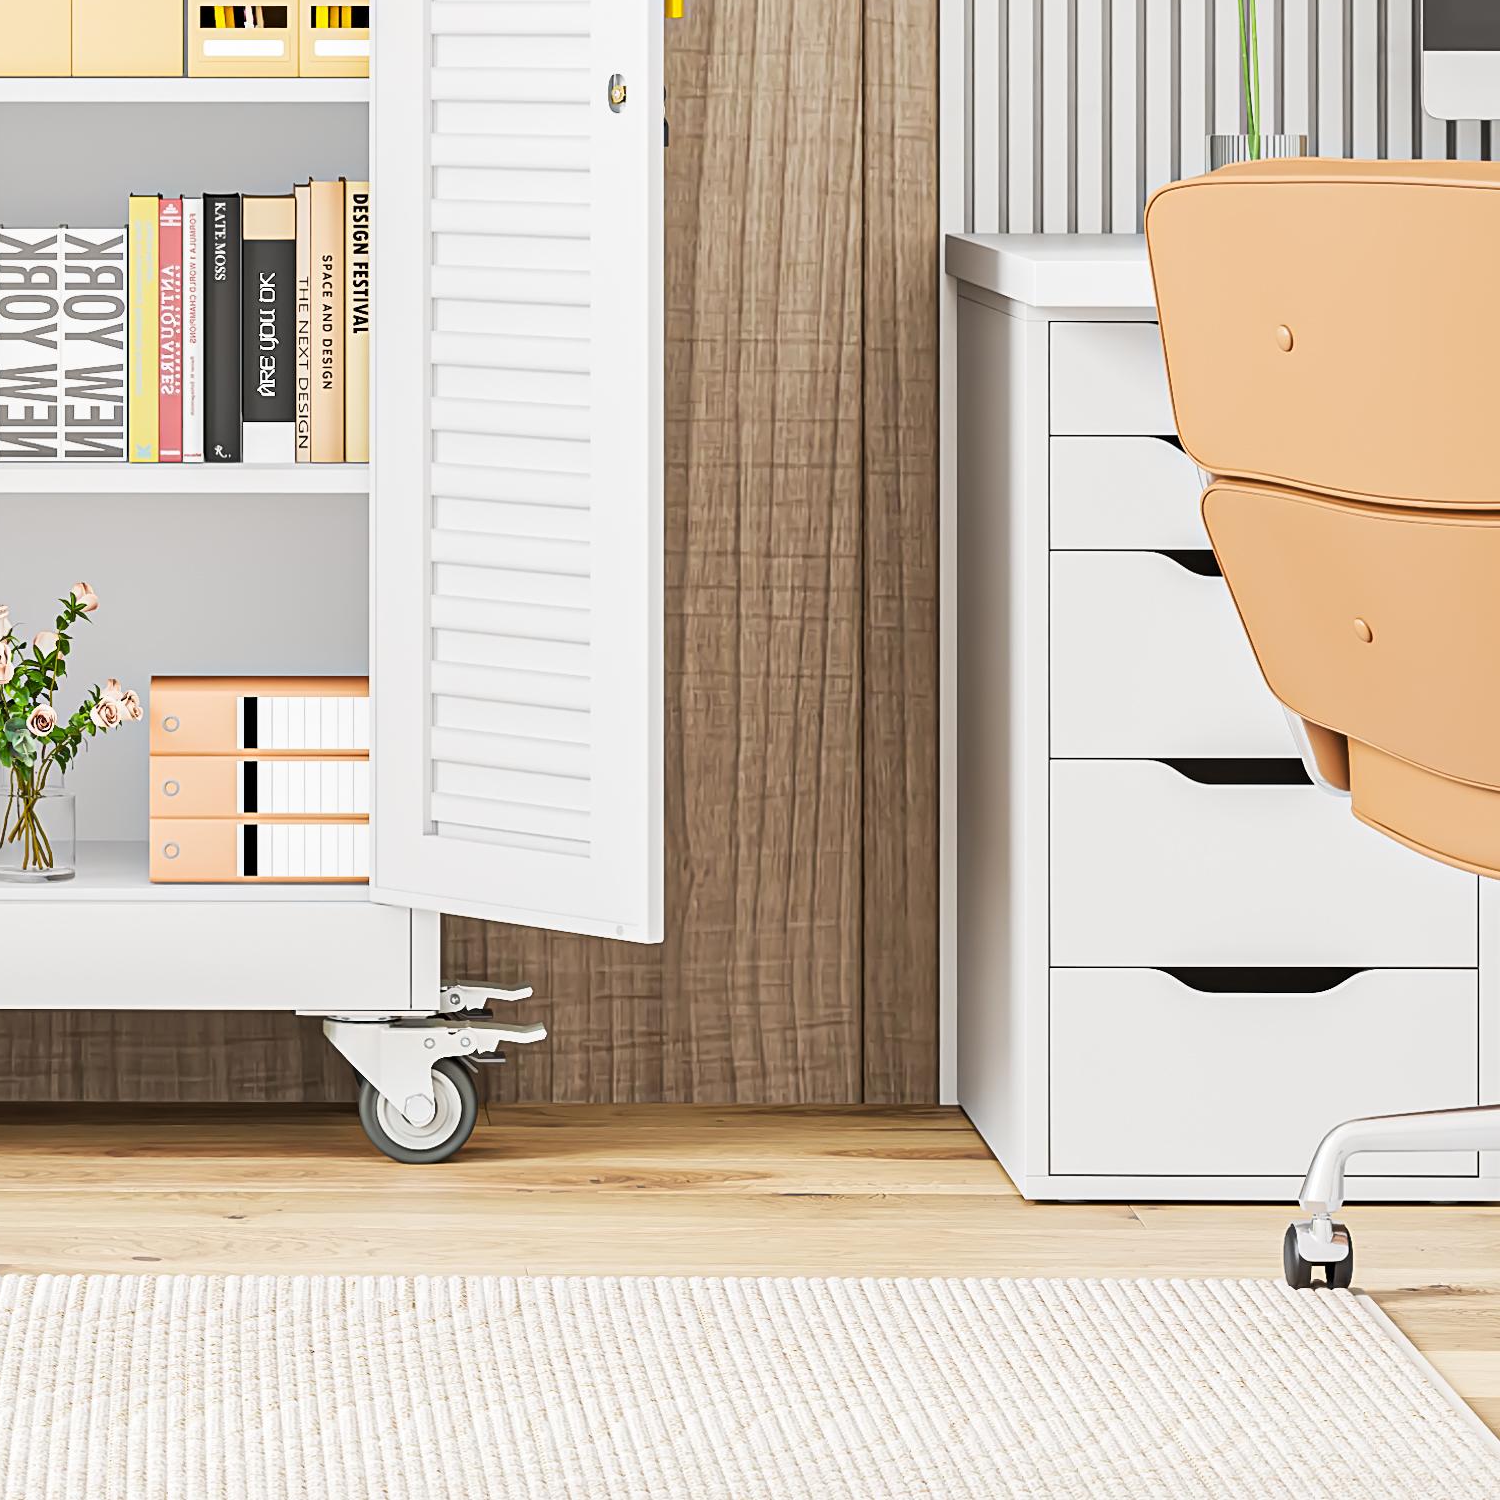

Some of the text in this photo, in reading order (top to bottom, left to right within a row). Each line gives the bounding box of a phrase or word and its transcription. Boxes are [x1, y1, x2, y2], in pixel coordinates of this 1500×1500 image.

[214, 202, 226, 281] KATE MOSS
[258, 272, 276, 304] OK
[352, 193, 370, 334] DESIGN FESTIVAL
[298, 276, 310, 449] THE NEXT DESIGN
[321, 255, 333, 390] SPACE AND DESIGN
